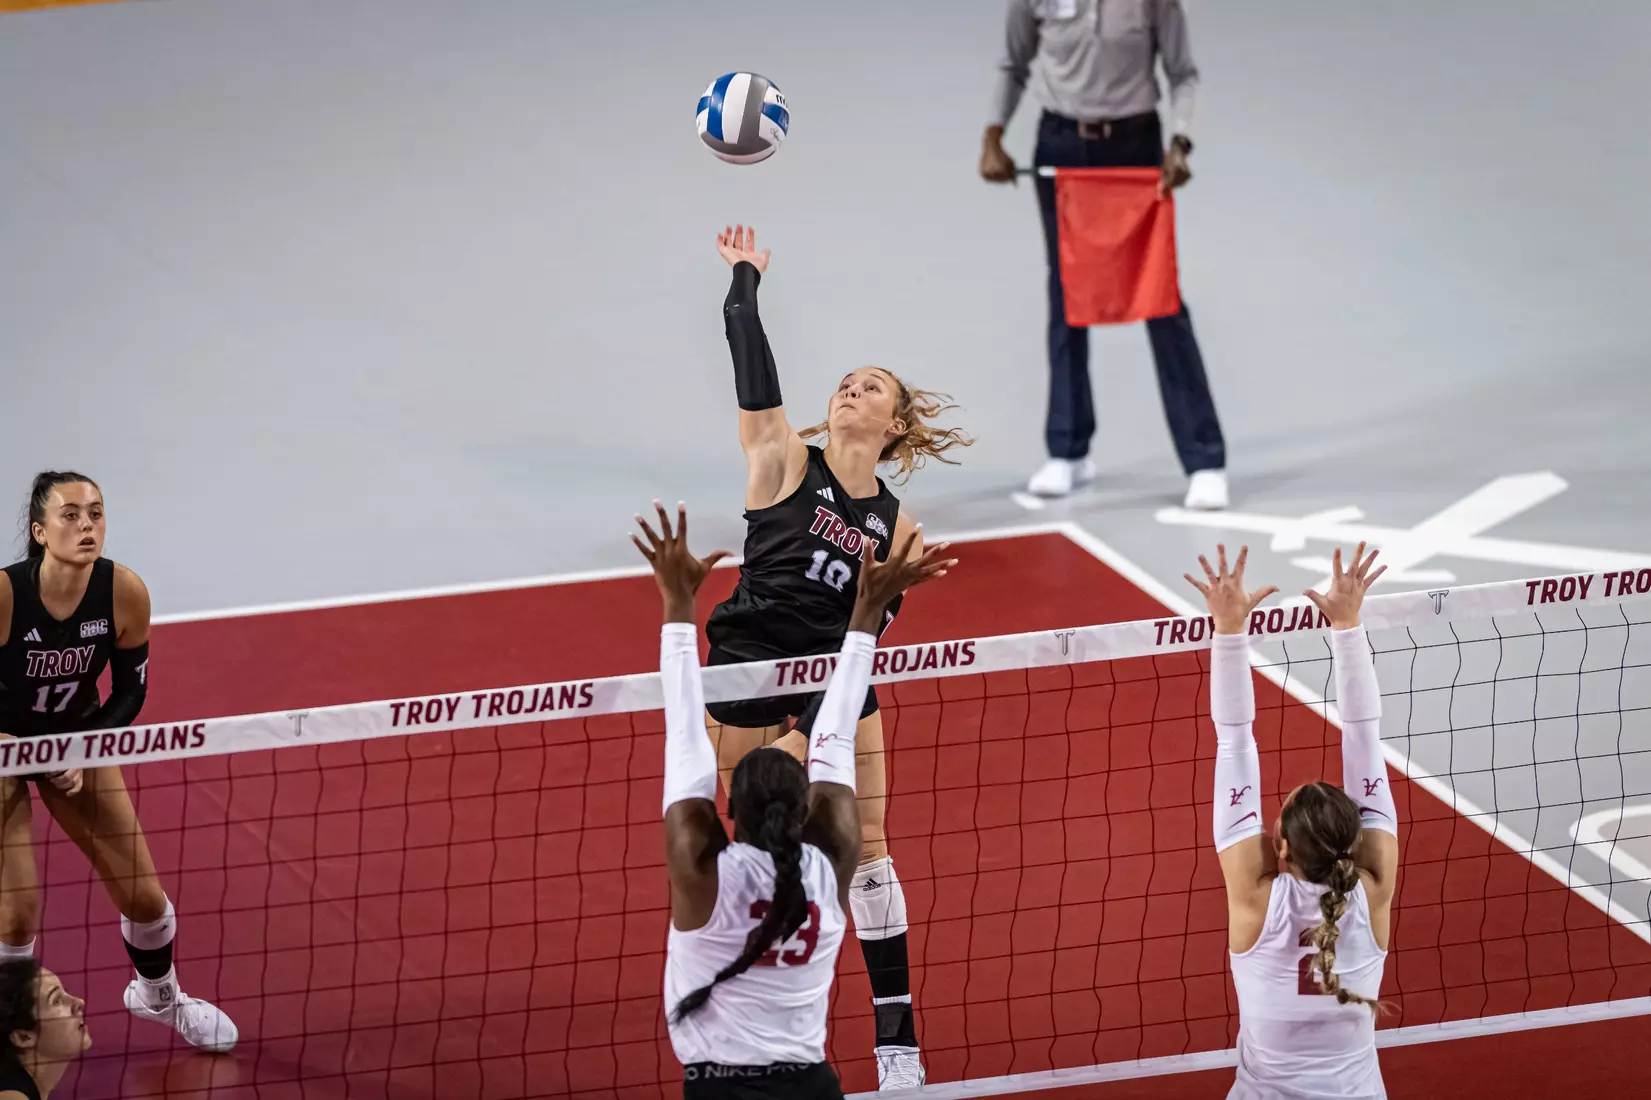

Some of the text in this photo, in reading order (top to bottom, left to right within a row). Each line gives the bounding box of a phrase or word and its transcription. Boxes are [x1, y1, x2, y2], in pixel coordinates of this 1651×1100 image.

[1526, 574, 1594, 606] TROY
[1249, 605, 1332, 636] ROJAN
[26, 644, 96, 678] TROY
[871, 641, 976, 676] ROJANS
[31, 680, 80, 713] 17
[390, 682, 594, 727] TROY TROJANS
[0, 723, 206, 767] TROY TROJANS
[704, 1064, 762, 1079] NIKE
